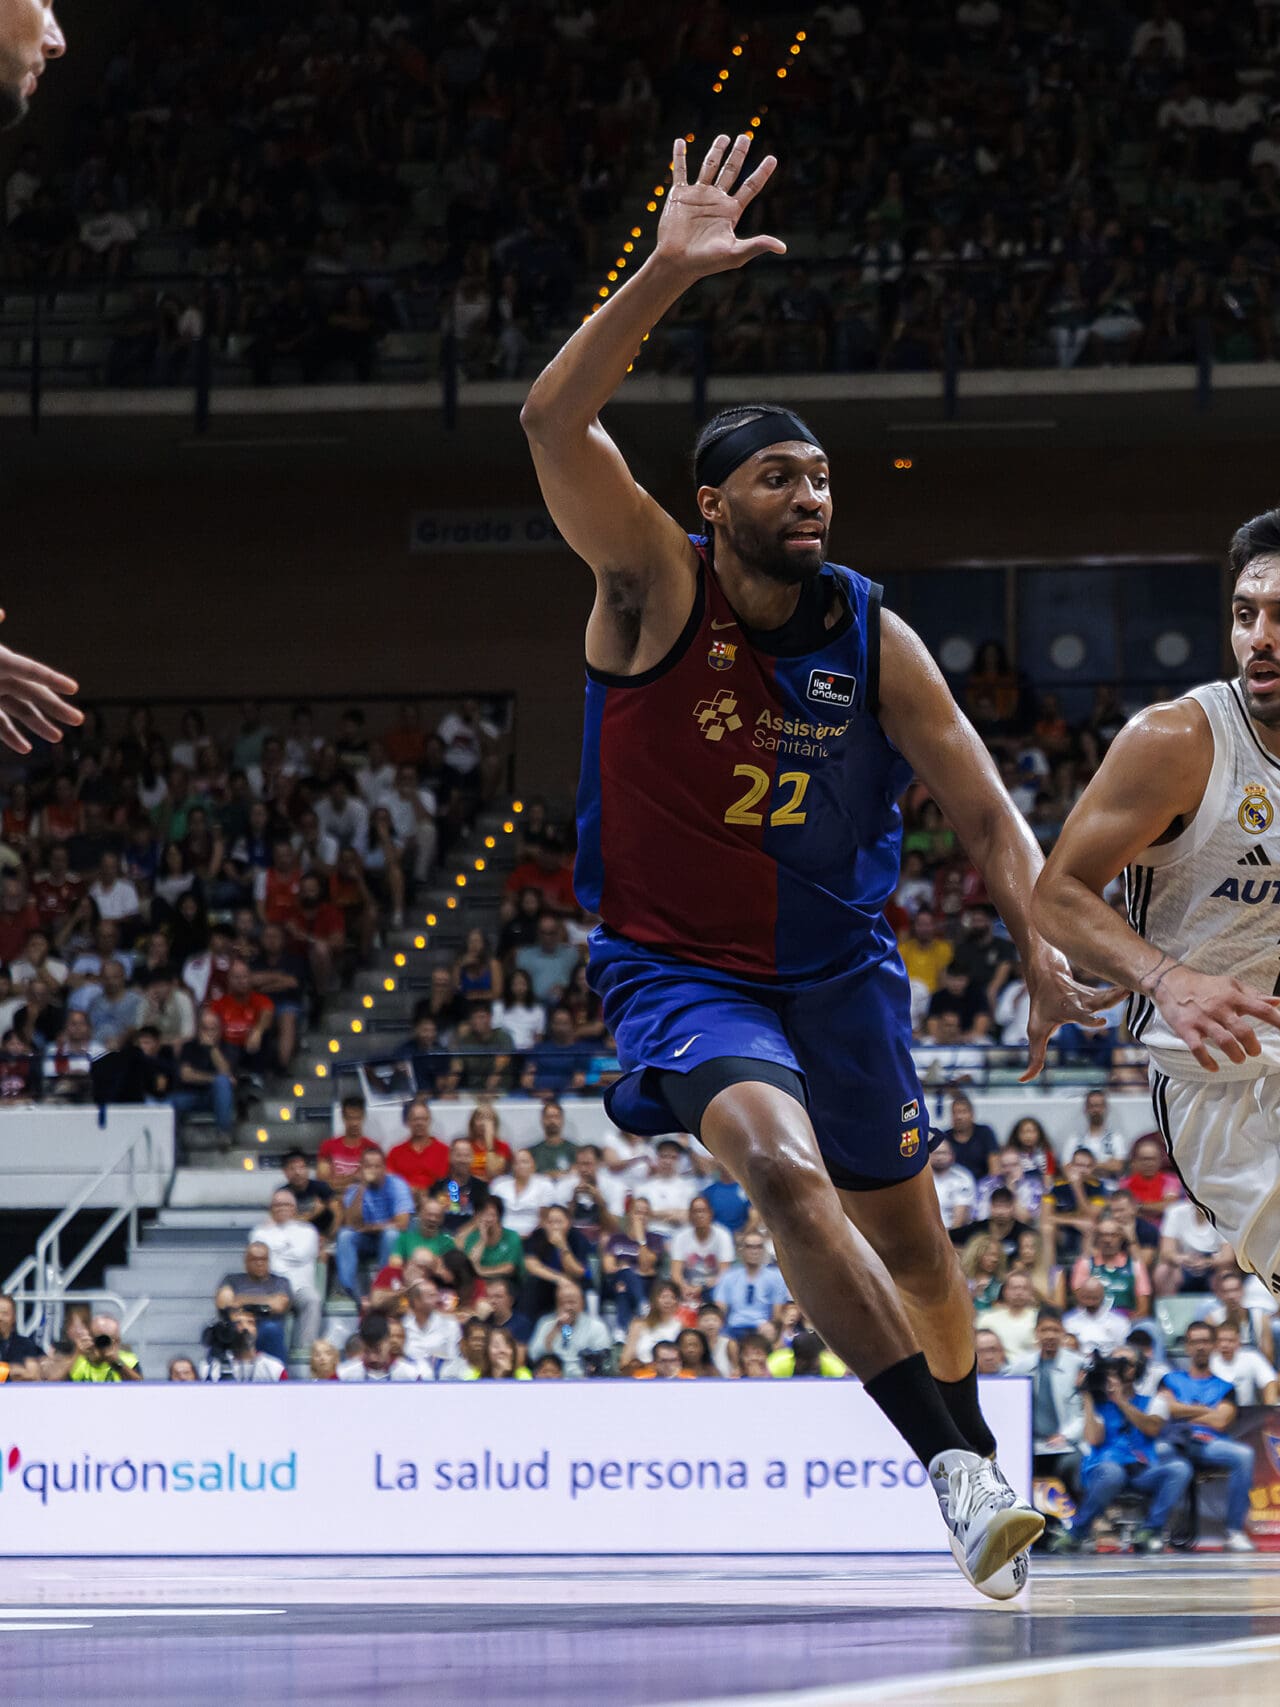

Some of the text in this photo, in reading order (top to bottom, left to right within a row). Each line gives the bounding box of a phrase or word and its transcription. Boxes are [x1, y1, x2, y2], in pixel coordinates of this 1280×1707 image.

[812, 689, 850, 702] endesa
[813, 679, 831, 690] liga
[755, 709, 853, 740] Assistènci
[724, 764, 811, 827] 22
[904, 1108, 915, 1119] acb
[22, 1449, 298, 1506] quirónsalud
[375, 1449, 928, 1500] La salud persona a perso
